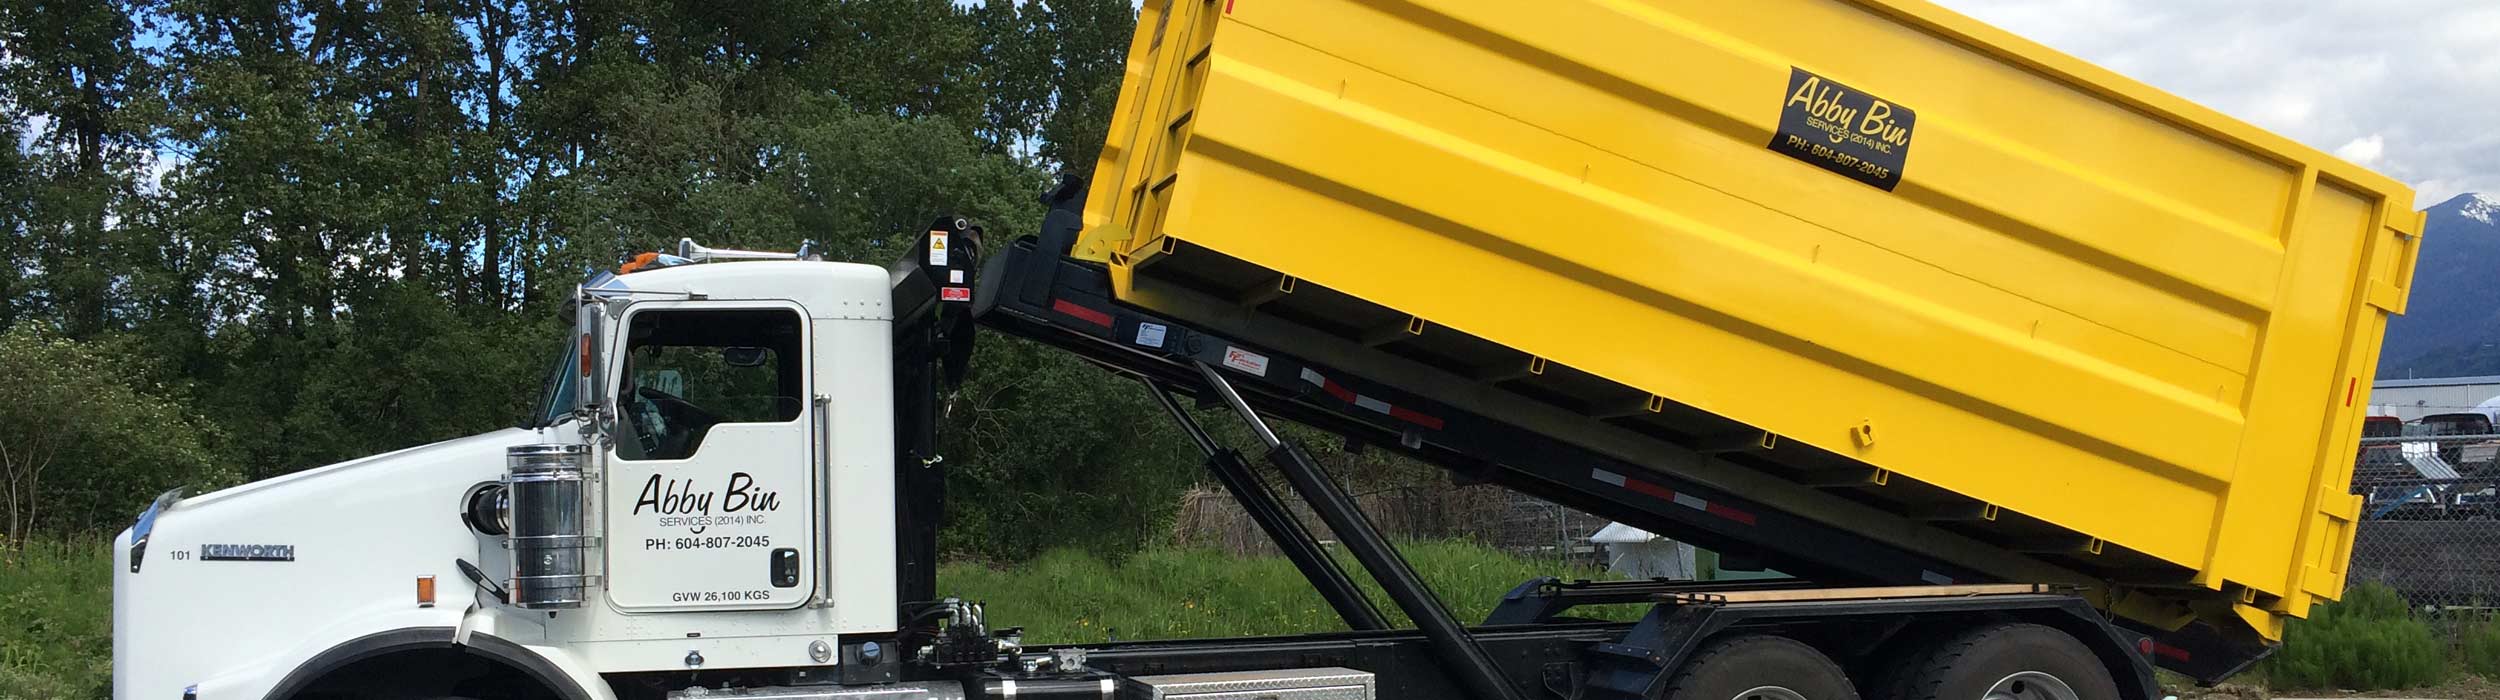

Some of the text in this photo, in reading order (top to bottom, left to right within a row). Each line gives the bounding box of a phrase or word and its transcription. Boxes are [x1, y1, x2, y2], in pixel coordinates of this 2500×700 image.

[1787, 76, 1908, 147] Abby Bin
[1806, 116, 1892, 155] SERVICES (2014) INC.
[1786, 134, 1890, 180] PH: 604-807-2045
[633, 472, 781, 534] Abby Bin
[659, 514, 767, 527] SERVICES (2014) INC.
[645, 536, 770, 550] PH: 604-807-2045
[170, 550, 190, 560] 101
[201, 544, 295, 559] KENWORTH
[672, 590, 770, 602] GVW 26,100 KGS
